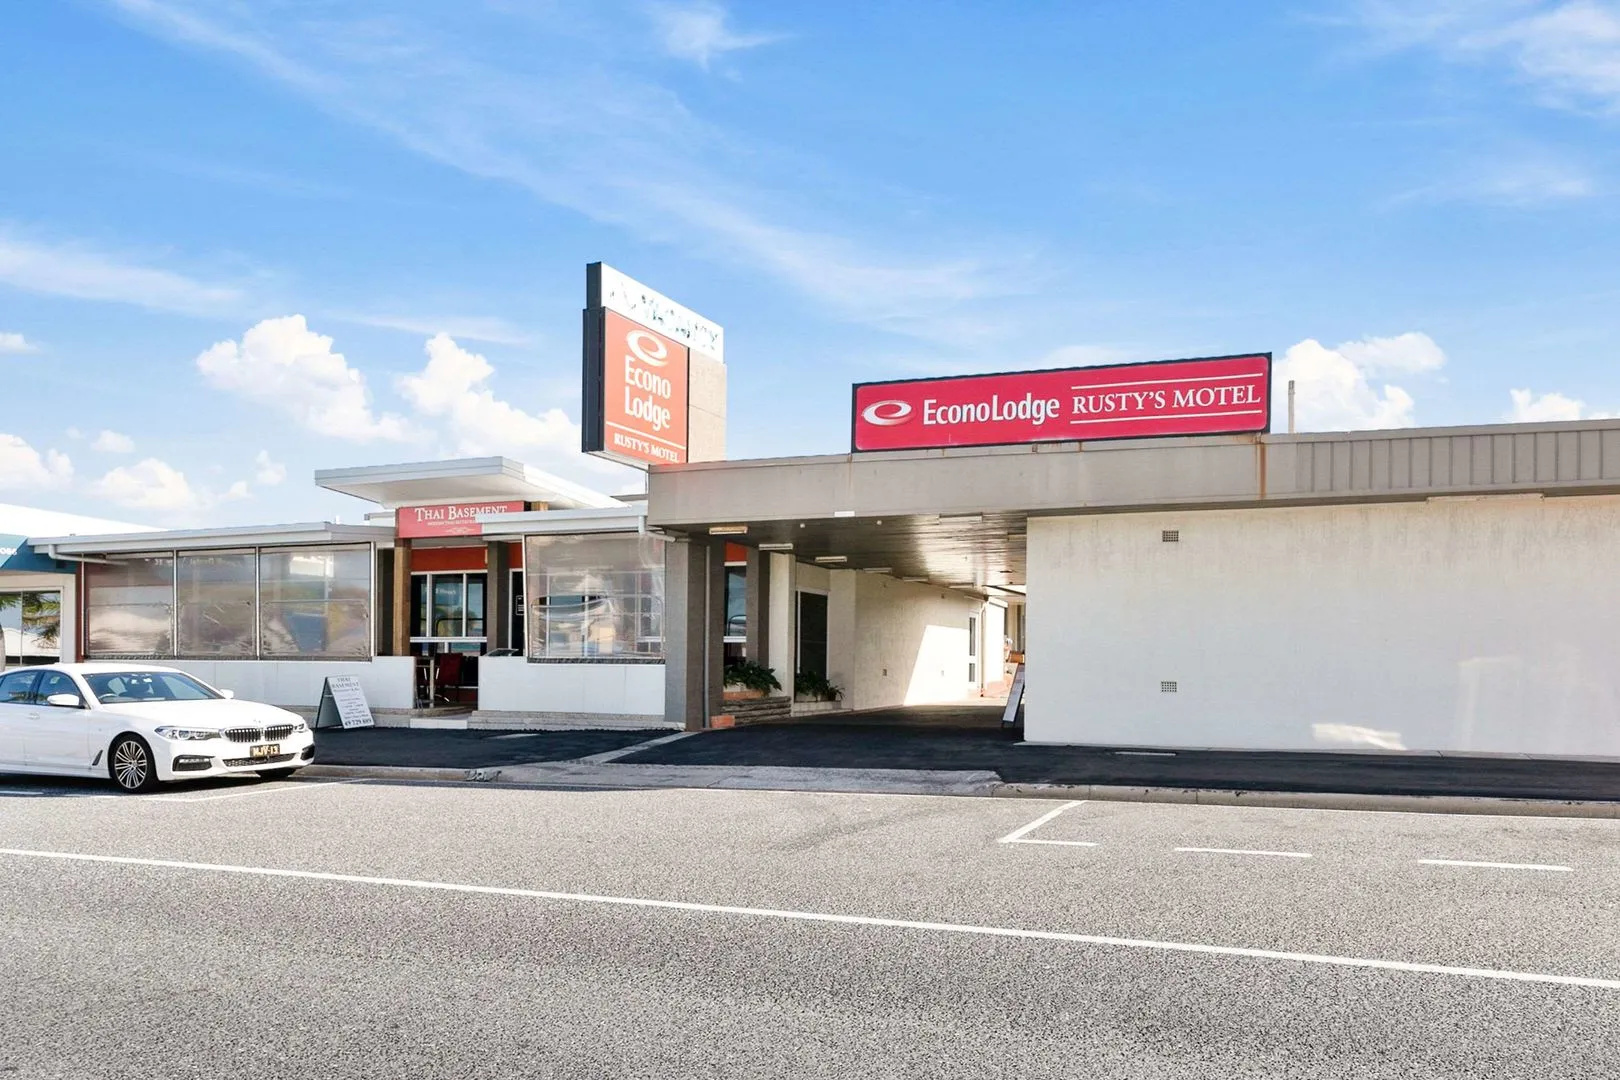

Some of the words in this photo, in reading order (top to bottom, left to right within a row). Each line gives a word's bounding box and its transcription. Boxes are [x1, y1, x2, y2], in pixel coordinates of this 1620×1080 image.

[625, 355, 670, 399] Econo
[625, 386, 670, 431] Lodge
[923, 392, 1060, 425] EconoLodge
[1072, 390, 1165, 414] RUSTY'S
[1172, 384, 1260, 408] MOTEL
[614, 433, 649, 453] RUSTY'S
[651, 445, 678, 462] MOTEL
[415, 508, 444, 521] THAI
[448, 505, 507, 519] BASEMENT
